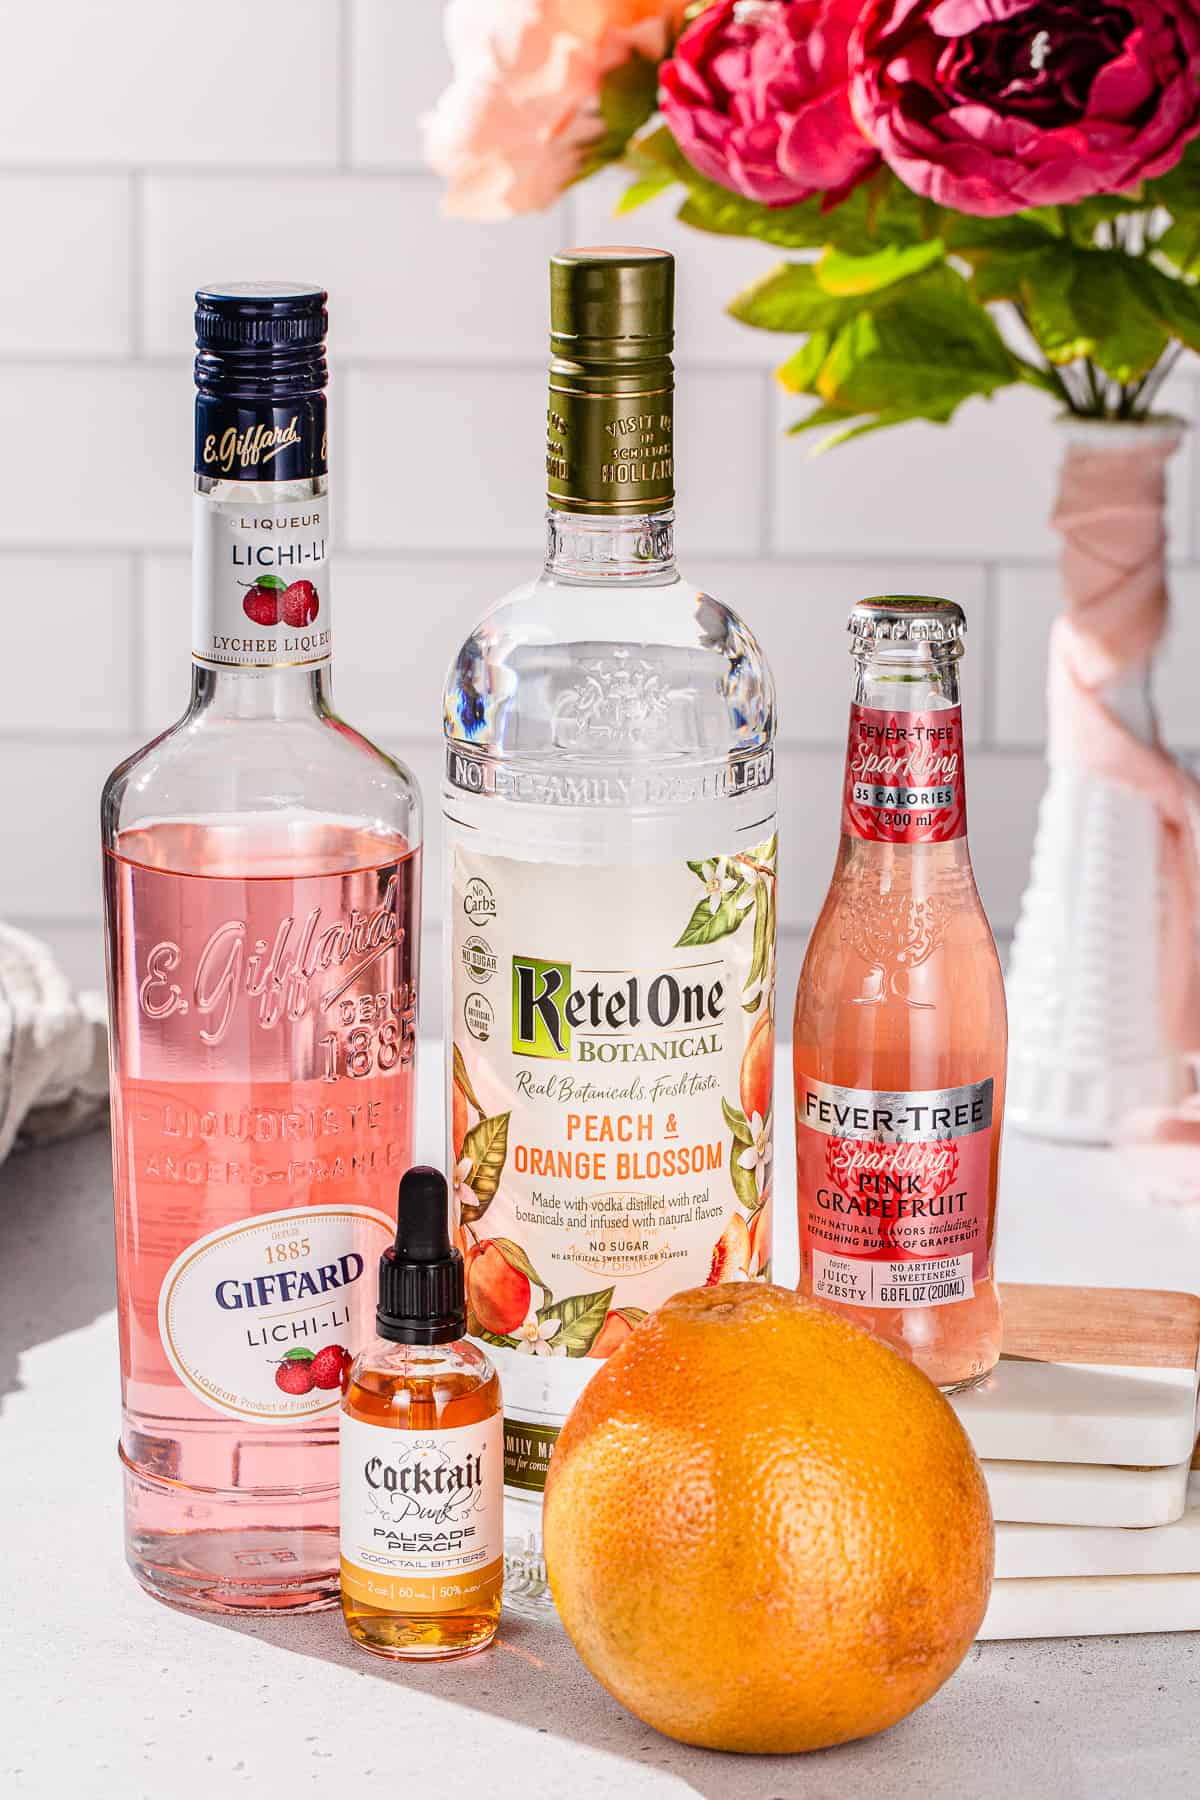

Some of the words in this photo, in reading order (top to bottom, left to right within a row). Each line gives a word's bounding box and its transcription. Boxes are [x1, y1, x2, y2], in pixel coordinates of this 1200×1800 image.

[605, 415, 652, 438] VISIT
[241, 514, 320, 530] LIQUEUR
[233, 539, 325, 566] LICHI-LI
[213, 636, 277, 652] LYCHEE
[285, 631, 331, 651] LIQUEU
[859, 723, 953, 740] FEVER-TREE
[851, 743, 959, 782] Sparkling
[855, 787, 869, 800] 35
[875, 791, 952, 805] CALORIES
[884, 814, 911, 826] 200
[915, 814, 932, 826] ml
[472, 885, 484, 897] No
[463, 896, 496, 914] Carbs
[462, 949, 471, 961] NO
[473, 952, 496, 970] SUGAR
[514, 965, 640, 1054] Ketel
[647, 974, 725, 1027] One
[319, 1018, 416, 1083] 1885
[577, 1034, 723, 1063] BOTANICAL
[515, 1070, 556, 1100] Real
[648, 1071, 690, 1103] Fresh
[806, 1092, 984, 1131] FEVER-TREE
[567, 1114, 652, 1142] PEACH
[664, 1113, 679, 1139] &
[515, 1145, 606, 1180] ORANGE
[616, 1141, 723, 1180] BLOSSOM
[834, 1141, 950, 1177] Sparkling
[859, 1173, 923, 1194] PINK
[531, 1191, 561, 1209] Made
[564, 1197, 588, 1211] with
[591, 1196, 623, 1212] vodka
[626, 1195, 665, 1211] distilled
[668, 1193, 690, 1209] with
[692, 1187, 709, 1203] real
[816, 1189, 968, 1219] GRAPEFRUIT
[515, 1206, 565, 1226] botanicals
[567, 1212, 587, 1228] and
[590, 1215, 629, 1229] infused
[632, 1213, 656, 1228] with
[659, 1207, 693, 1225] natural
[695, 1204, 724, 1220] flavors
[808, 1213, 827, 1226] WITH
[828, 1220, 874, 1236] NATURAL
[876, 1227, 926, 1237] FLAVORS
[928, 1219, 973, 1235] including
[972, 1216, 978, 1225] A
[589, 1241, 606, 1252] NO
[610, 1240, 650, 1252] SUGAR
[807, 1224, 860, 1247] REFRESHING
[863, 1239, 900, 1249] BURST
[902, 1240, 917, 1250] OF
[919, 1228, 979, 1249] GRAPEFRUIT
[264, 1238, 311, 1265] 1885
[562, 1254, 600, 1263] ARTIFICIAL
[602, 1255, 649, 1263] SWEETENERS
[660, 1249, 689, 1261] FLAVORS
[823, 1268, 858, 1286] JUICY
[890, 1263, 905, 1273] NO
[907, 1257, 961, 1273] ARTIFICIAL
[892, 1269, 957, 1283] SWEETENERS
[827, 1285, 867, 1301] ZESTY
[880, 1287, 897, 1302] 6.8
[898, 1286, 911, 1302] FL
[912, 1285, 926, 1302] OZ
[927, 1278, 966, 1302] (200ML)
[247, 1306, 351, 1347] LICHI-LI
[193, 1368, 238, 1404] LIQUEUR
[240, 1398, 277, 1411] Product
[279, 1401, 288, 1410] of
[290, 1398, 321, 1410] France
[506, 1435, 532, 1456] MILY
[538, 1440, 554, 1459] MA
[364, 1453, 482, 1496] Cocktail
[390, 1488, 474, 1525] Punk
[373, 1526, 476, 1542] PALISADE
[388, 1540, 462, 1552] PEACH
[359, 1551, 428, 1568] COCKTAIL
[430, 1550, 487, 1568] BITTERS
[440, 1584, 463, 1598] 50%
